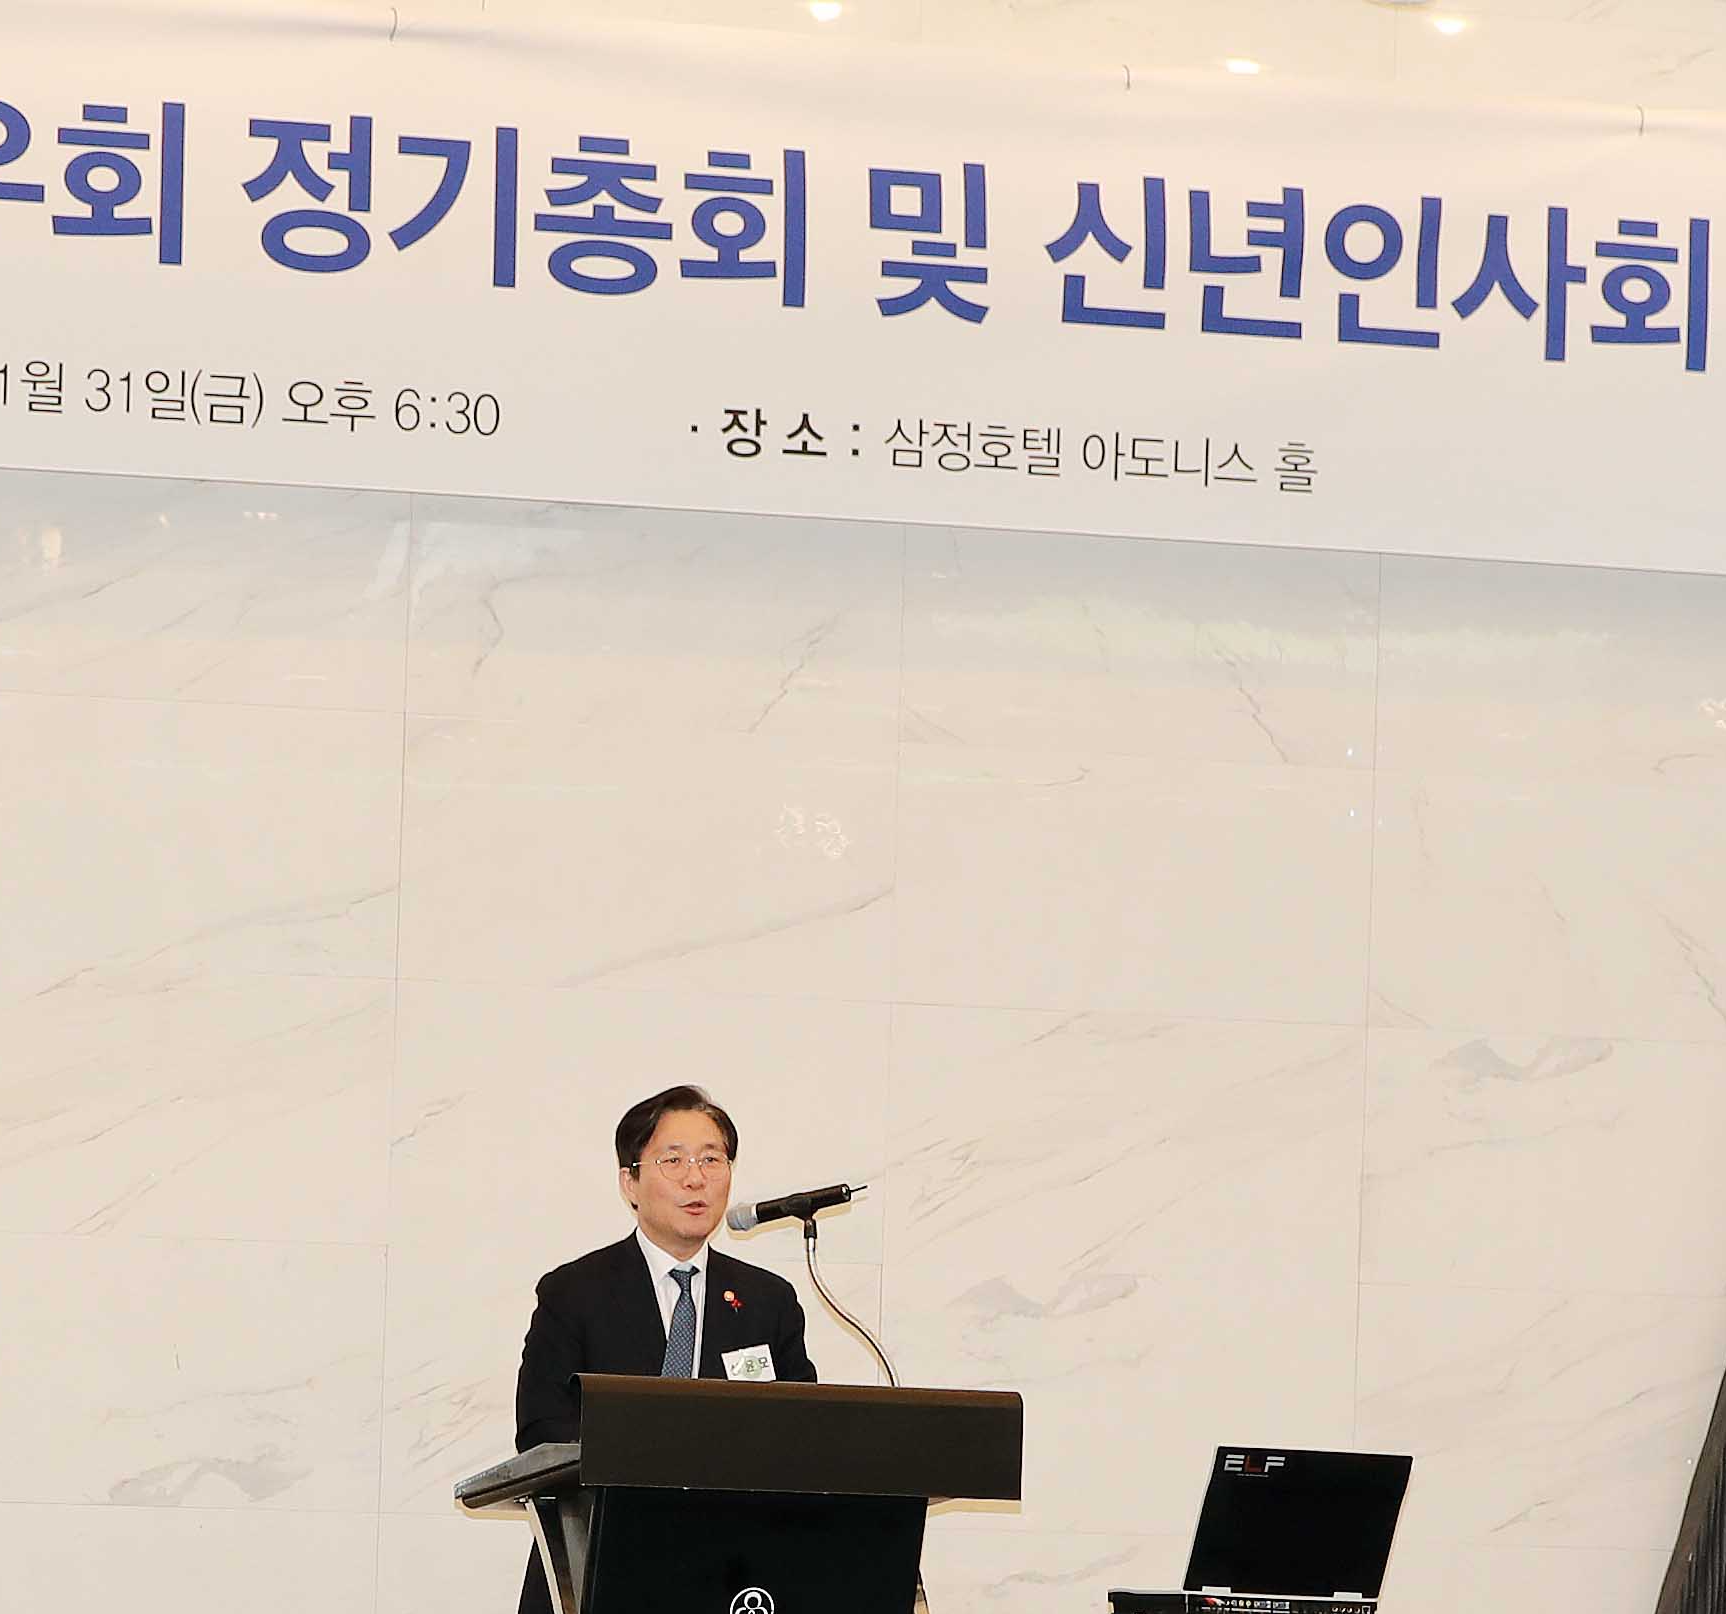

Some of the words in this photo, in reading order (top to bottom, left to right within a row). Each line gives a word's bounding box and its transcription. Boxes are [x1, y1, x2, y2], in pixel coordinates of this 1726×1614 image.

[242, 116, 806, 308] 정기총회
[868, 163, 990, 324] 및
[1045, 177, 1710, 373] 신년인사회
[84, 368, 264, 430] 31일(금)
[281, 380, 377, 433] 오후
[394, 387, 500, 437] 6:30
[884, 418, 1061, 478] 삼정호텔
[1082, 431, 1258, 488] 아도니스
[1273, 441, 1319, 494] 홀
